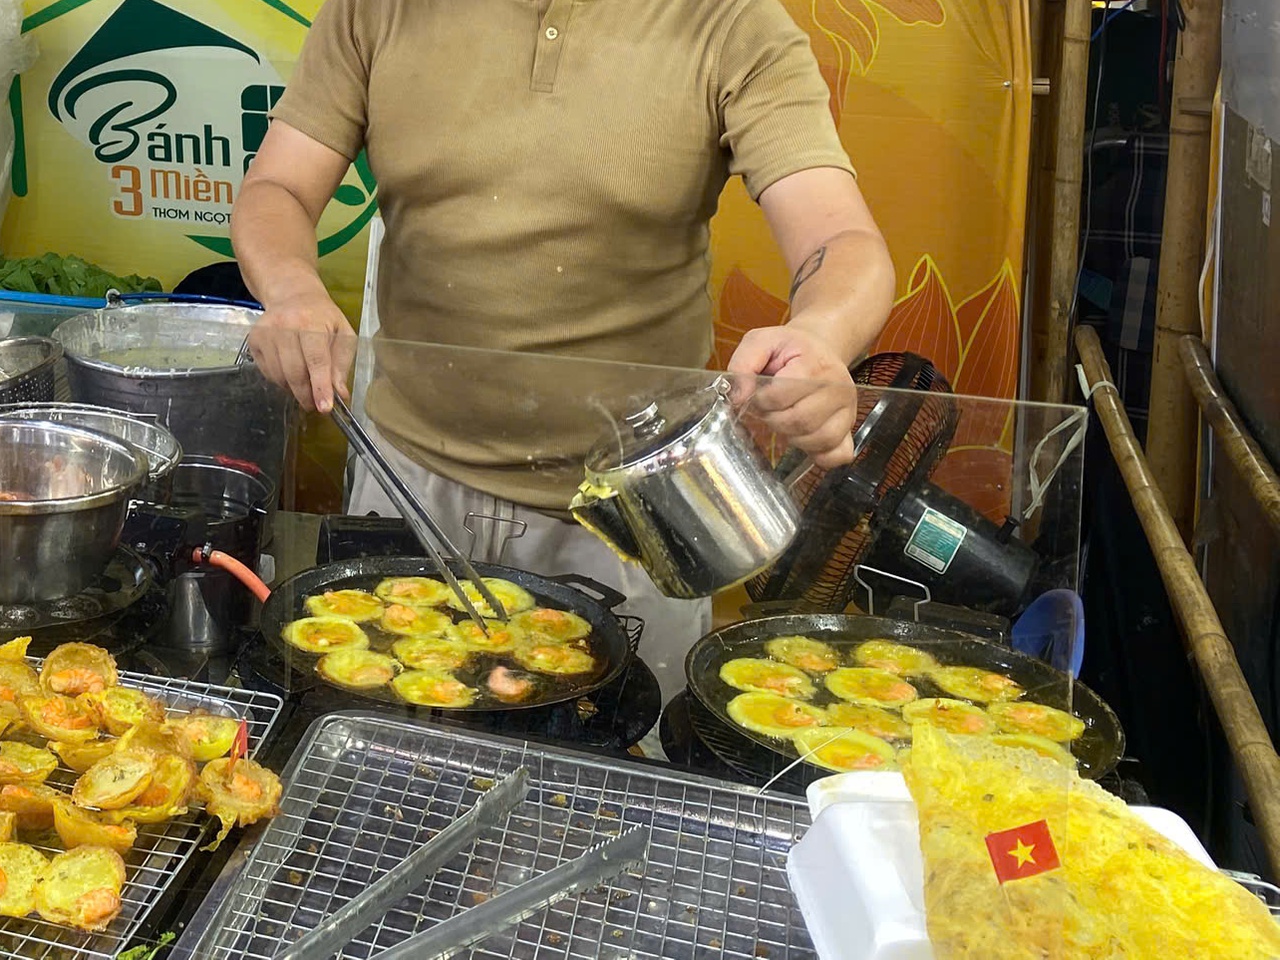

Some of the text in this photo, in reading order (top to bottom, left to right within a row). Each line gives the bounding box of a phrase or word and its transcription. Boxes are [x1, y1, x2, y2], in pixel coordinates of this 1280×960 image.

[64, 69, 231, 167] Bánh
[111, 165, 143, 217] 3
[152, 206, 233, 225] THƠM NGỌT
